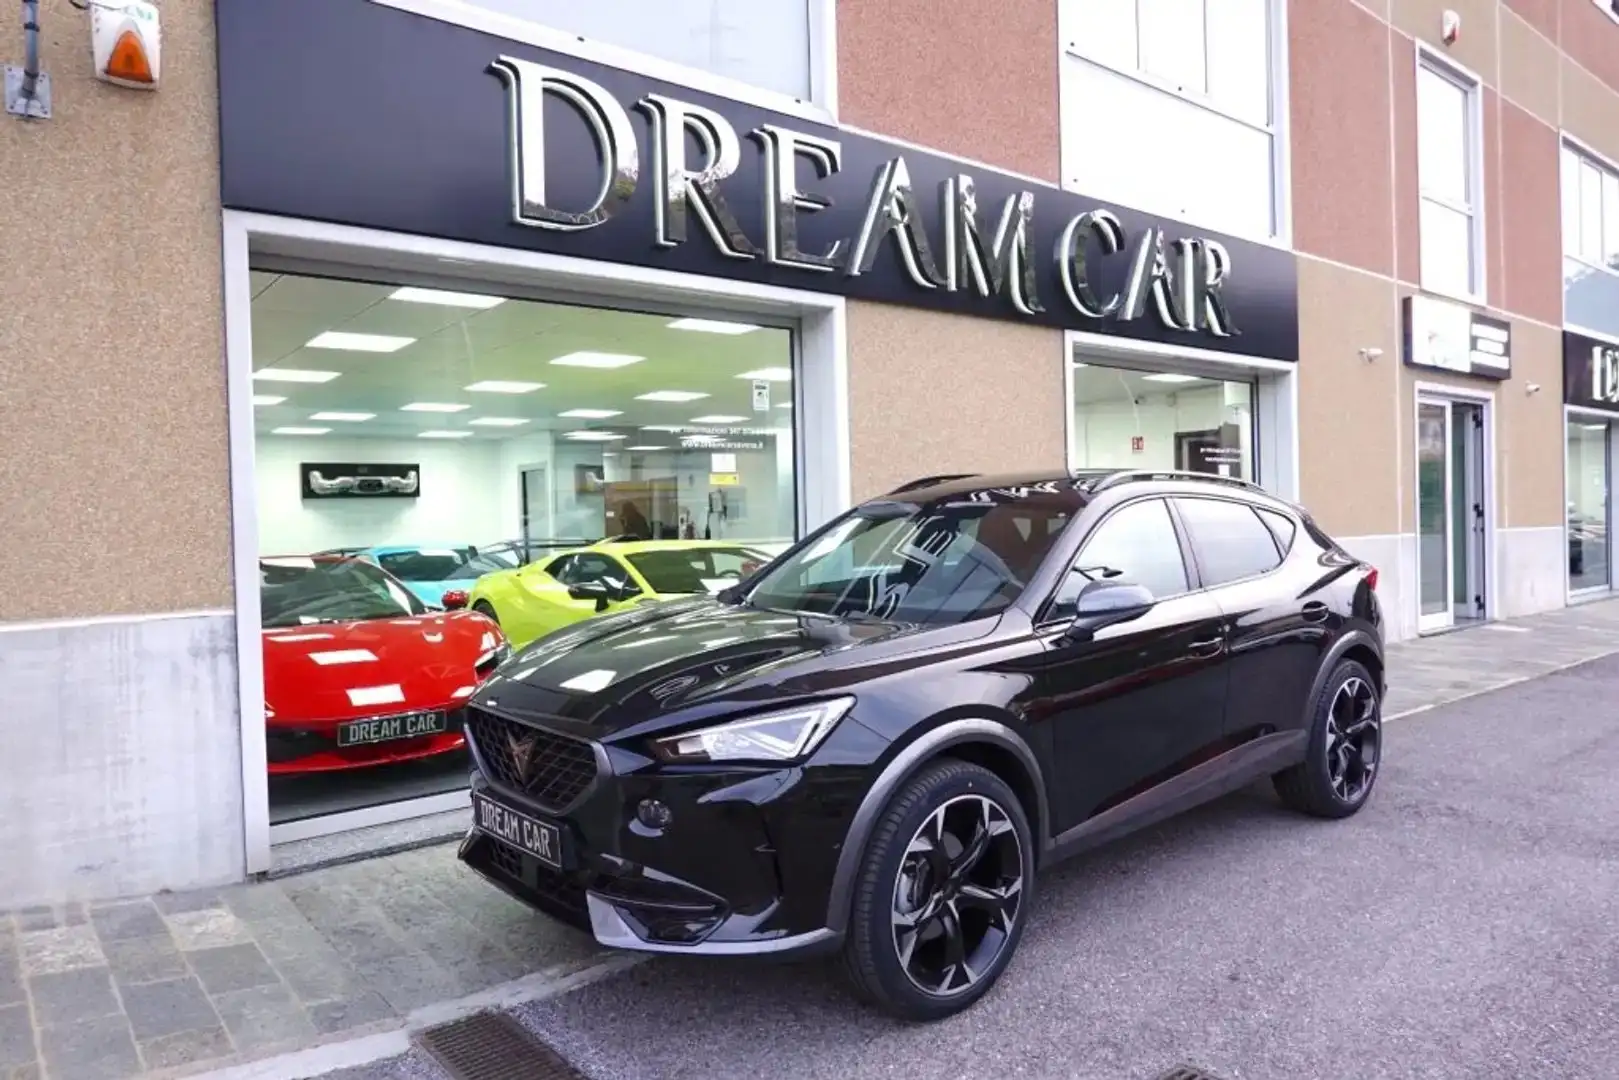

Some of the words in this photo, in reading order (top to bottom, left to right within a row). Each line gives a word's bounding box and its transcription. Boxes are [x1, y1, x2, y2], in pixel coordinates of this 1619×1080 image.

[488, 54, 1045, 315] DREAM
[1058, 208, 1240, 337] CAR
[349, 719, 401, 742] DREAM
[406, 713, 437, 733] CAR
[480, 800, 520, 844] DREAM
[523, 820, 552, 859] CAR
